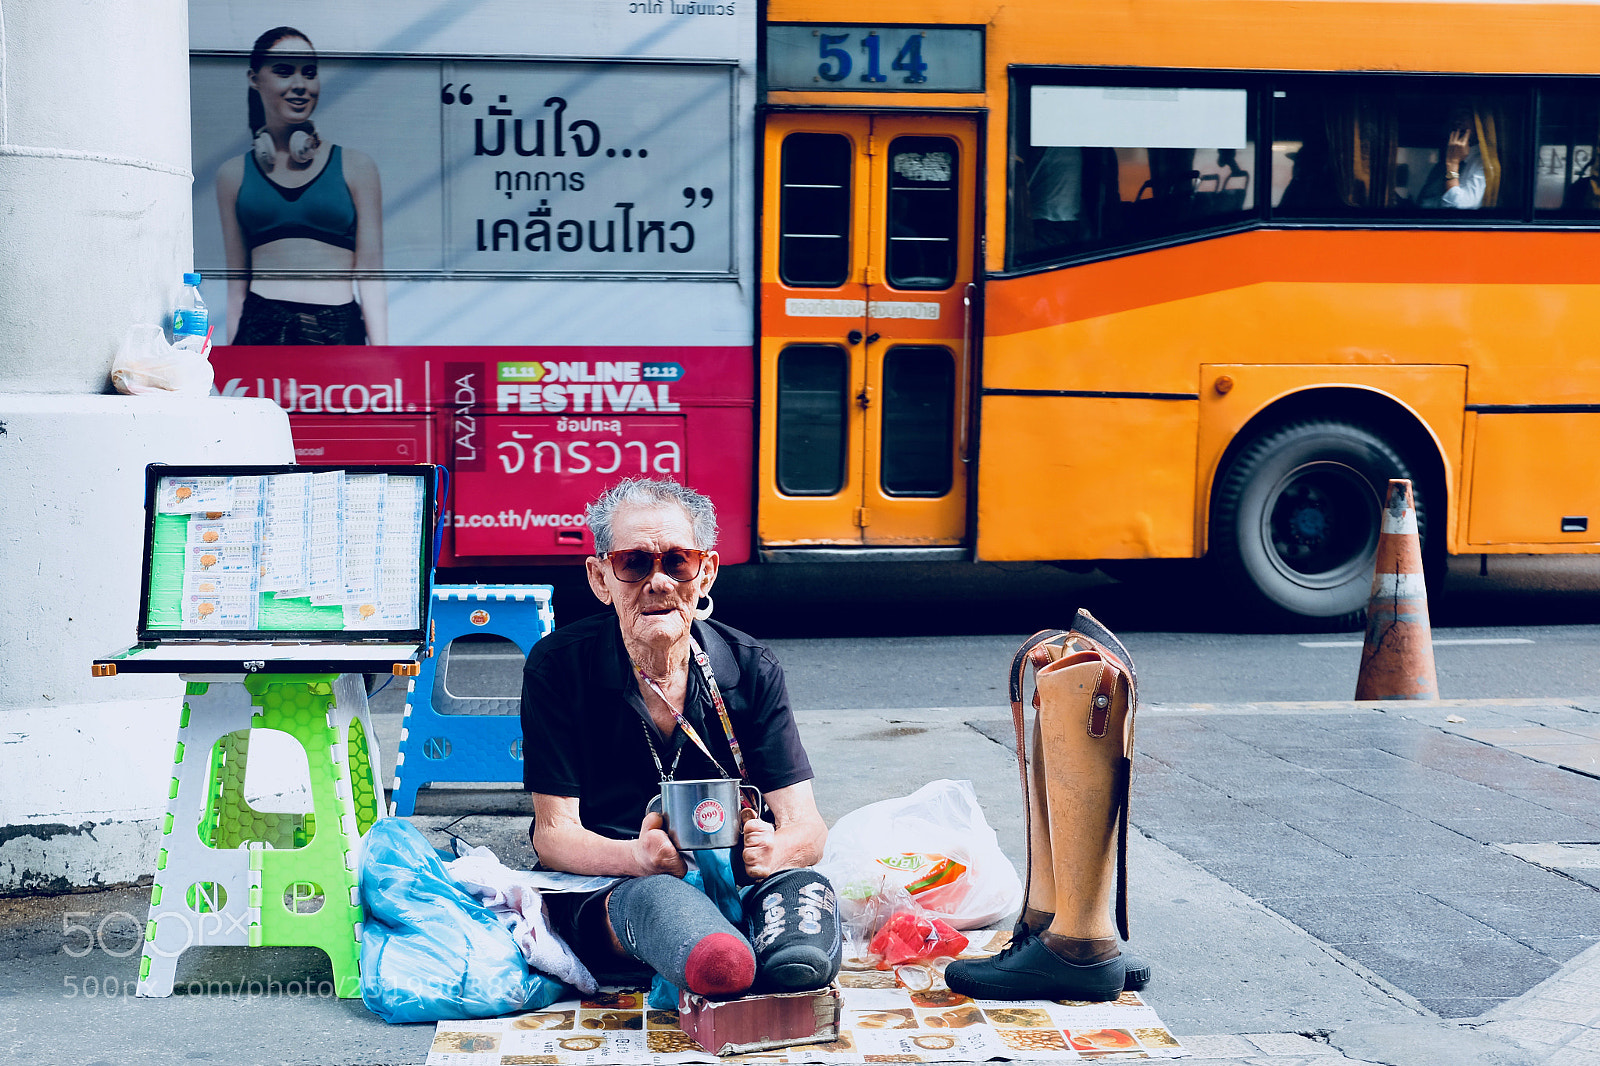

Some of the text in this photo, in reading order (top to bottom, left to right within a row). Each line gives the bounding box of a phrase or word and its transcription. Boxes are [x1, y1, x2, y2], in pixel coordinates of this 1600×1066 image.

[817, 33, 928, 83] 514
[495, 170, 585, 199] ทุกการ
[501, 366, 537, 378] 11.11
[643, 366, 678, 378] 12.12
[496, 384, 681, 413] FESTIVAL
[455, 373, 477, 461] LAZADA
[556, 416, 622, 437] ช้อปทะลุ
[294, 446, 325, 456] acoal
[496, 430, 681, 475] จักรวาล
[701, 809, 718, 821] 999
